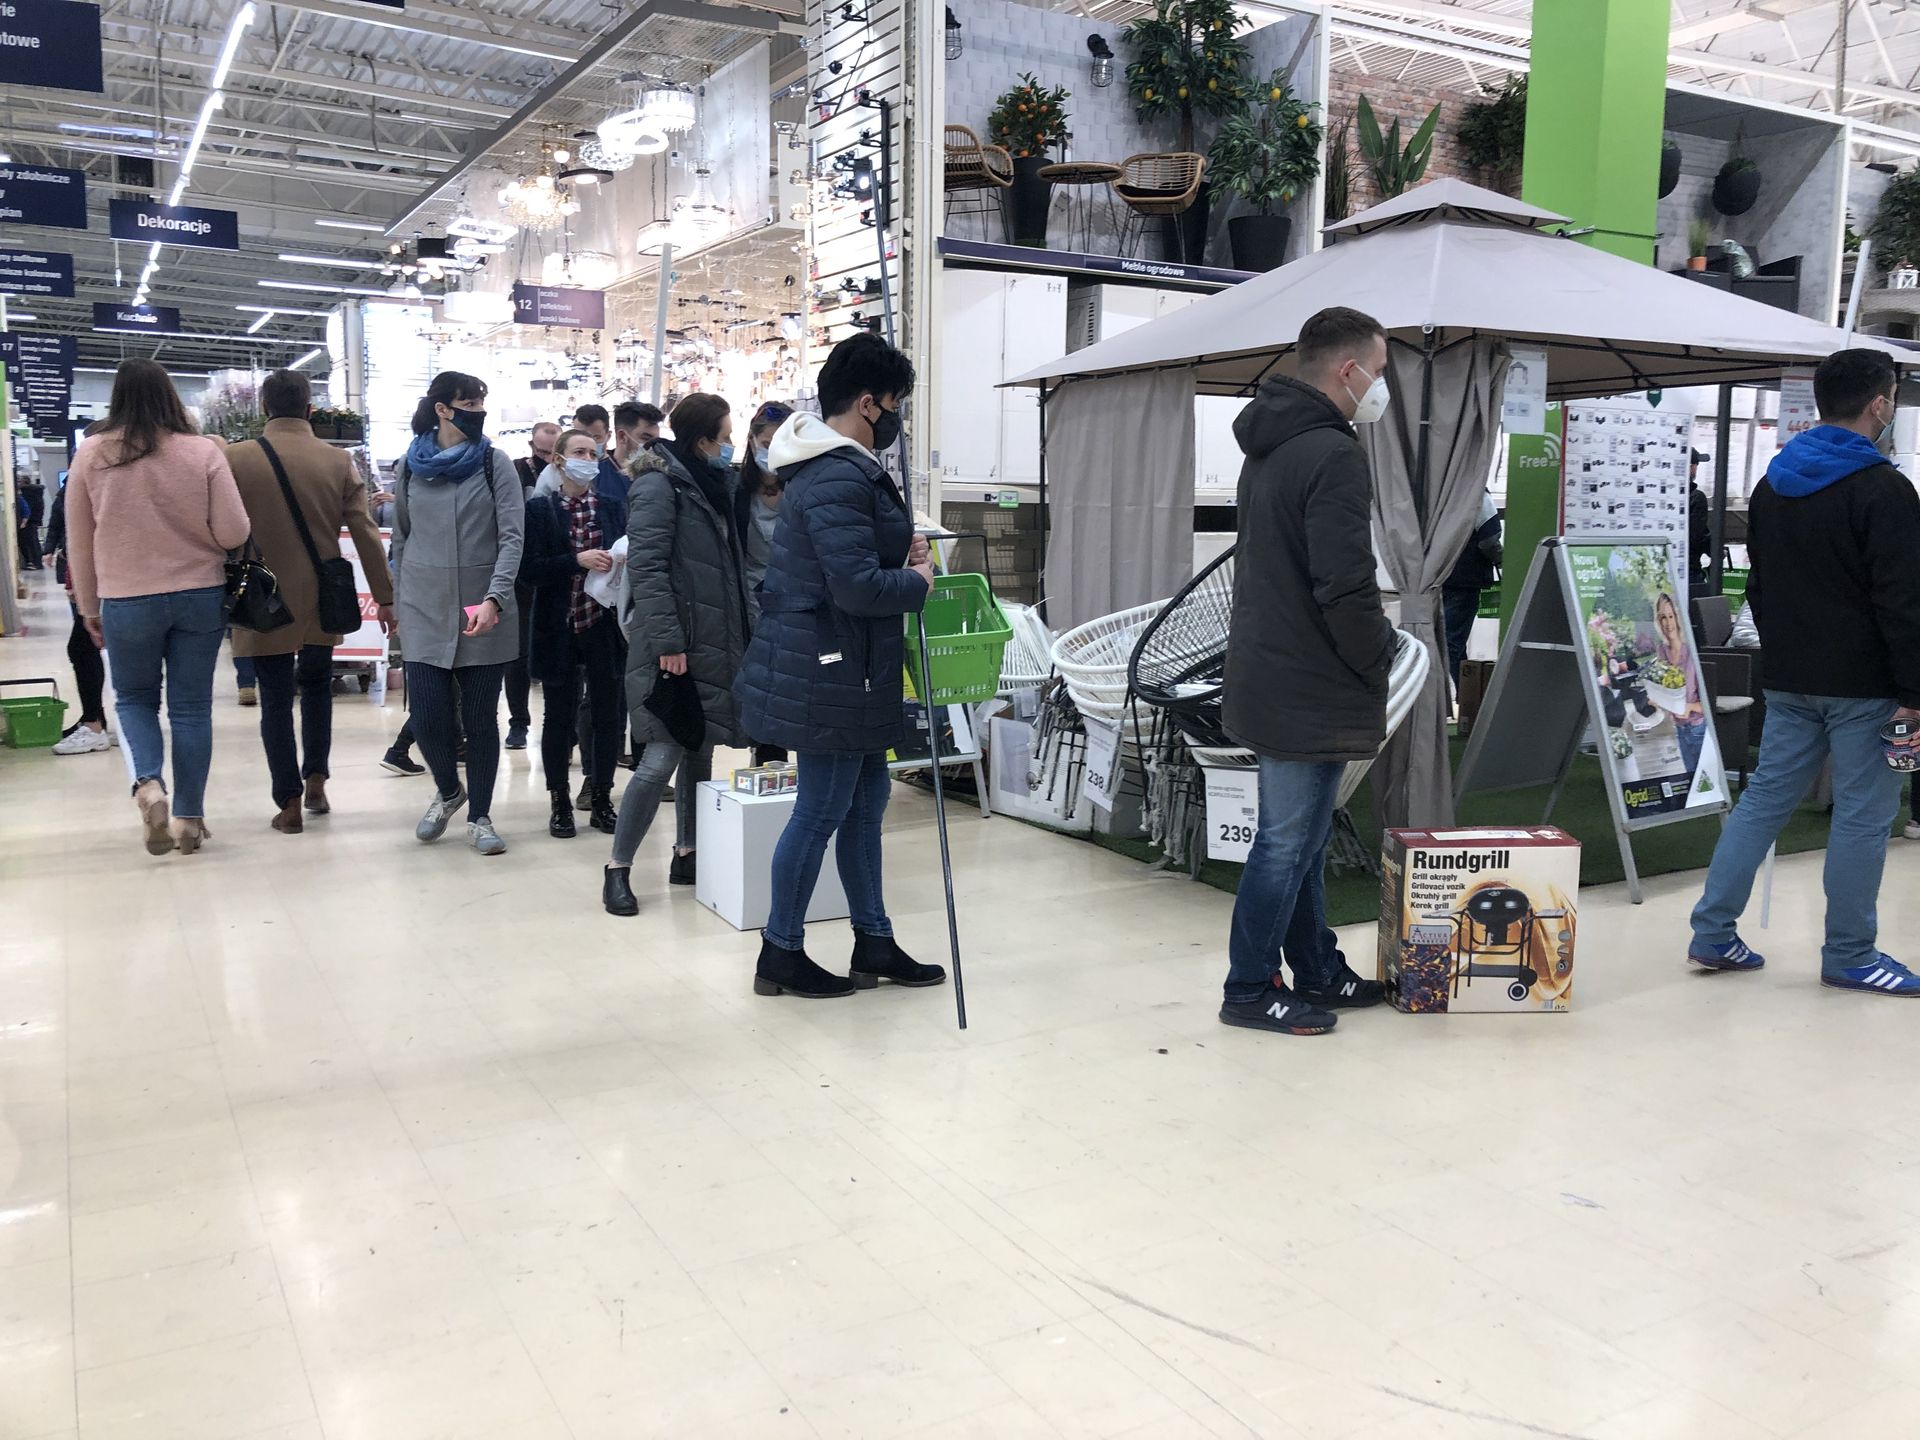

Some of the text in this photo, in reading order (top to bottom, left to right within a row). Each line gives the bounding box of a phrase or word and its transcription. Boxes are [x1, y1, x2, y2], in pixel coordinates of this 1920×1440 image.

[137, 213, 211, 235] Dekoracje
[1121, 261, 1185, 276] Meble ogrodowe
[519, 299, 532, 310] 12
[2, 343, 14, 351] 17
[1519, 455, 1549, 468] Free
[1088, 770, 1104, 789] 238
[1624, 787, 1648, 808] Ogród
[1220, 824, 1252, 844] 239
[1413, 850, 1510, 873] Rundgrill
[1442, 893, 1456, 901] grill
[1339, 981, 1357, 997] N
[1266, 1002, 1289, 1020] N
